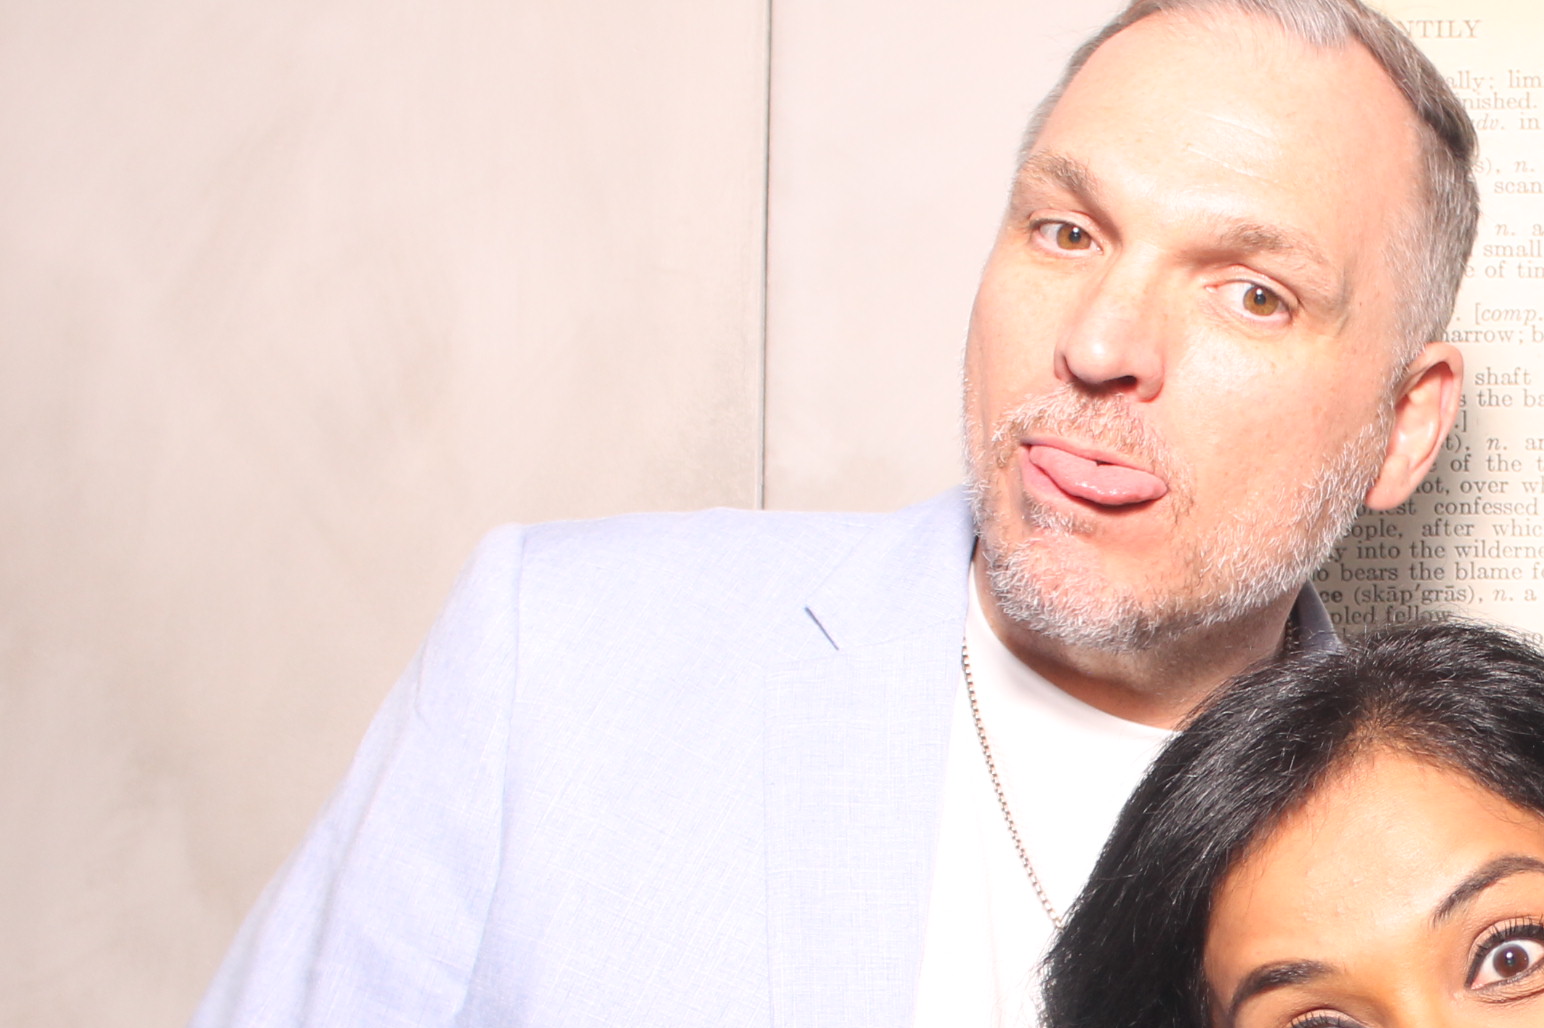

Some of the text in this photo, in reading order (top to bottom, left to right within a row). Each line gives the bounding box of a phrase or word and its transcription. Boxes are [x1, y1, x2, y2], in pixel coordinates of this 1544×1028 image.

[1465, 91, 1537, 110] nished.
[1519, 116, 1541, 130] in
[1483, 241, 1543, 258] small
[1484, 260, 1507, 278] of
[1473, 367, 1531, 386] shaft
[1475, 389, 1513, 408] the
[1449, 454, 1472, 473] of
[1486, 454, 1522, 472] the
[1458, 479, 1509, 493] over
[1432, 497, 1539, 516] confessed
[1348, 520, 1403, 541] ople,
[1421, 519, 1475, 538] after
[1364, 542, 1401, 559] into
[1408, 541, 1446, 559] the
[1340, 564, 1399, 582] bears
[1408, 562, 1446, 582] the
[1454, 562, 1522, 581] blame
[1524, 589, 1537, 601] a
